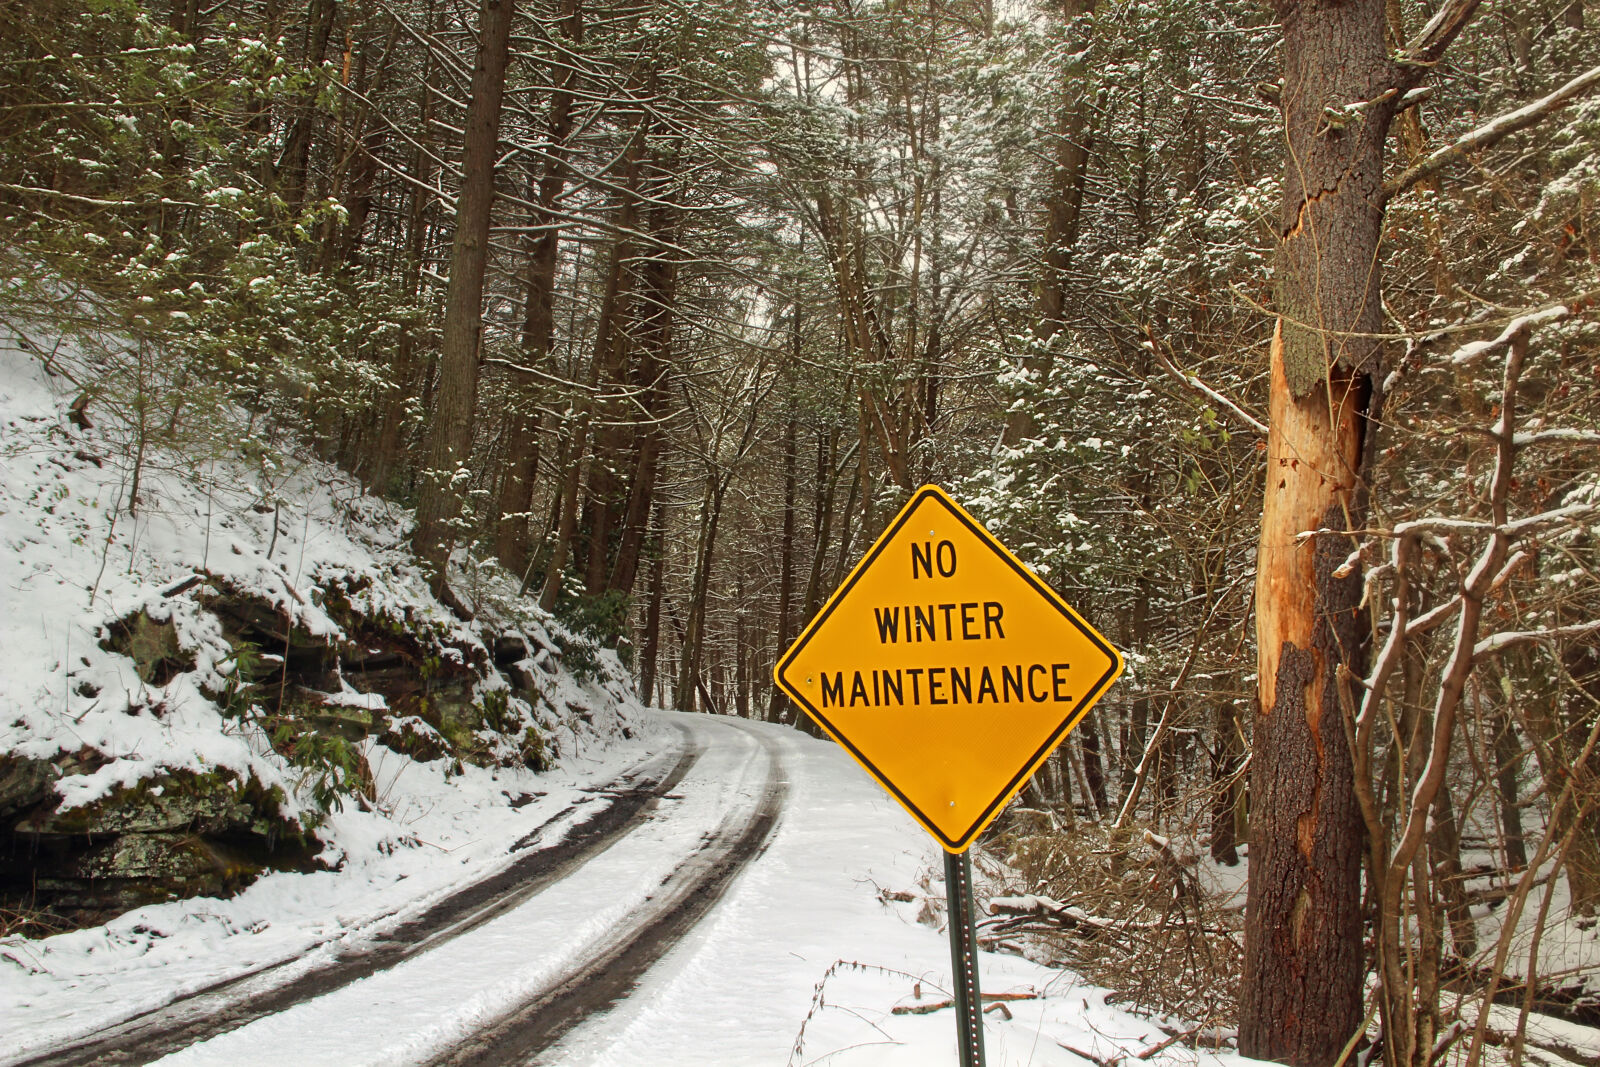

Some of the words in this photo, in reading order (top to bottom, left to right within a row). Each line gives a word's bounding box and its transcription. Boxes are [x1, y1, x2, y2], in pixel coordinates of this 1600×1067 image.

[911, 540, 957, 579] NO
[874, 601, 1005, 644] WINTER
[820, 663, 1073, 708] MAINTENANCE
